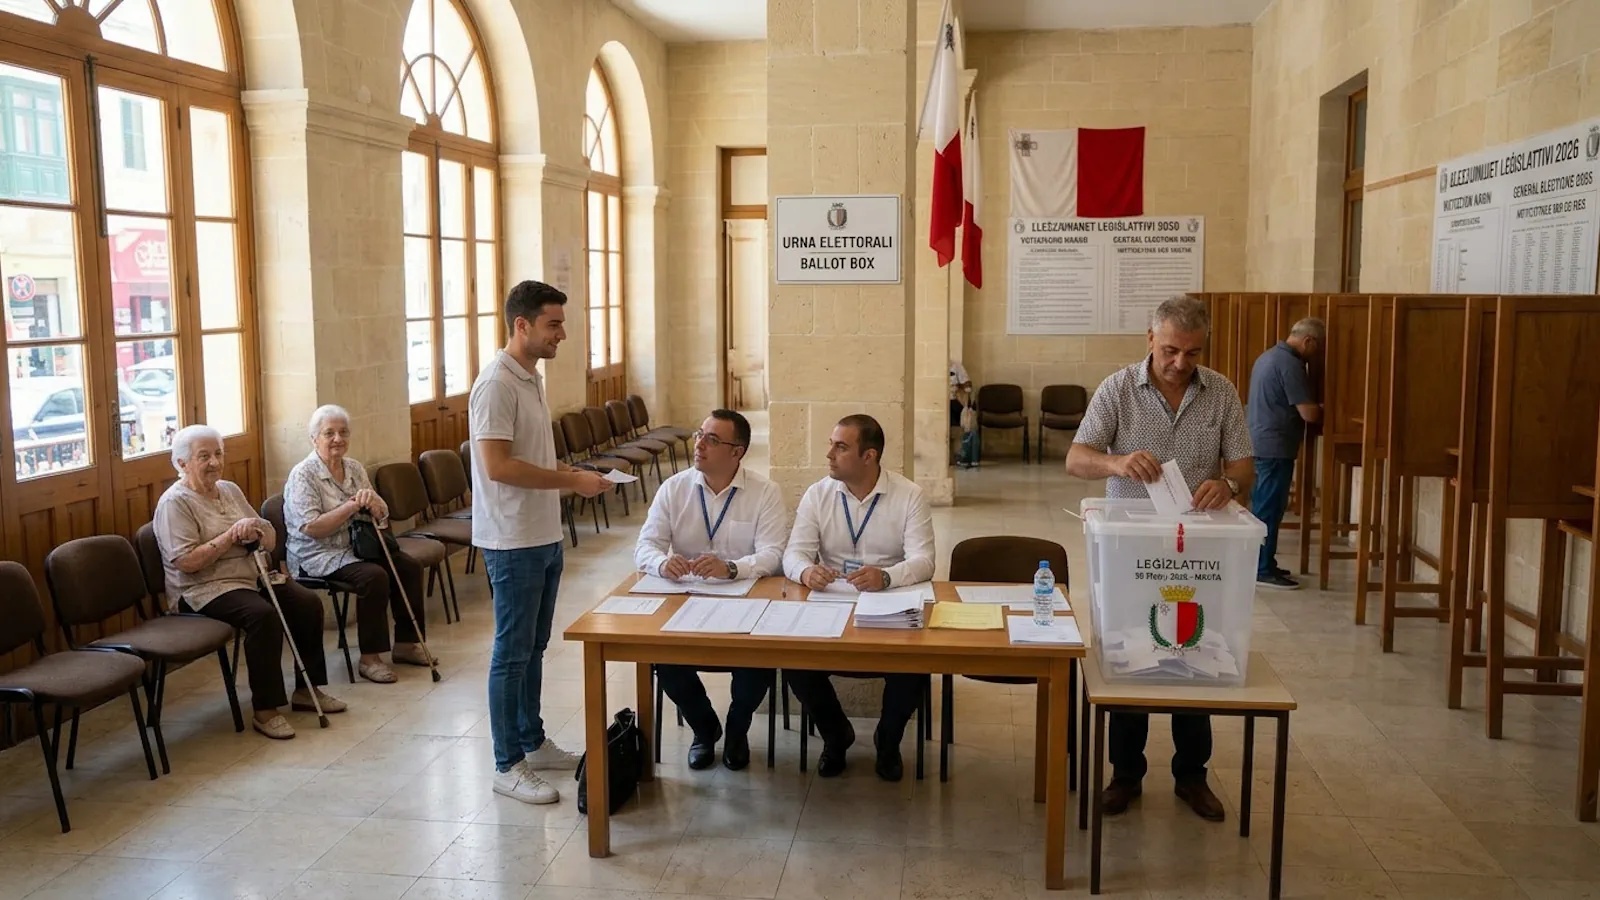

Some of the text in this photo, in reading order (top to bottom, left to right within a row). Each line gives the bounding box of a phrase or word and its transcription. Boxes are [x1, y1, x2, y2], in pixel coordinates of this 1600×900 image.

[1555, 138, 1579, 163] 2026
[783, 236, 892, 248] URNA ELETTORALI
[801, 257, 875, 269] BALLOT BOX
